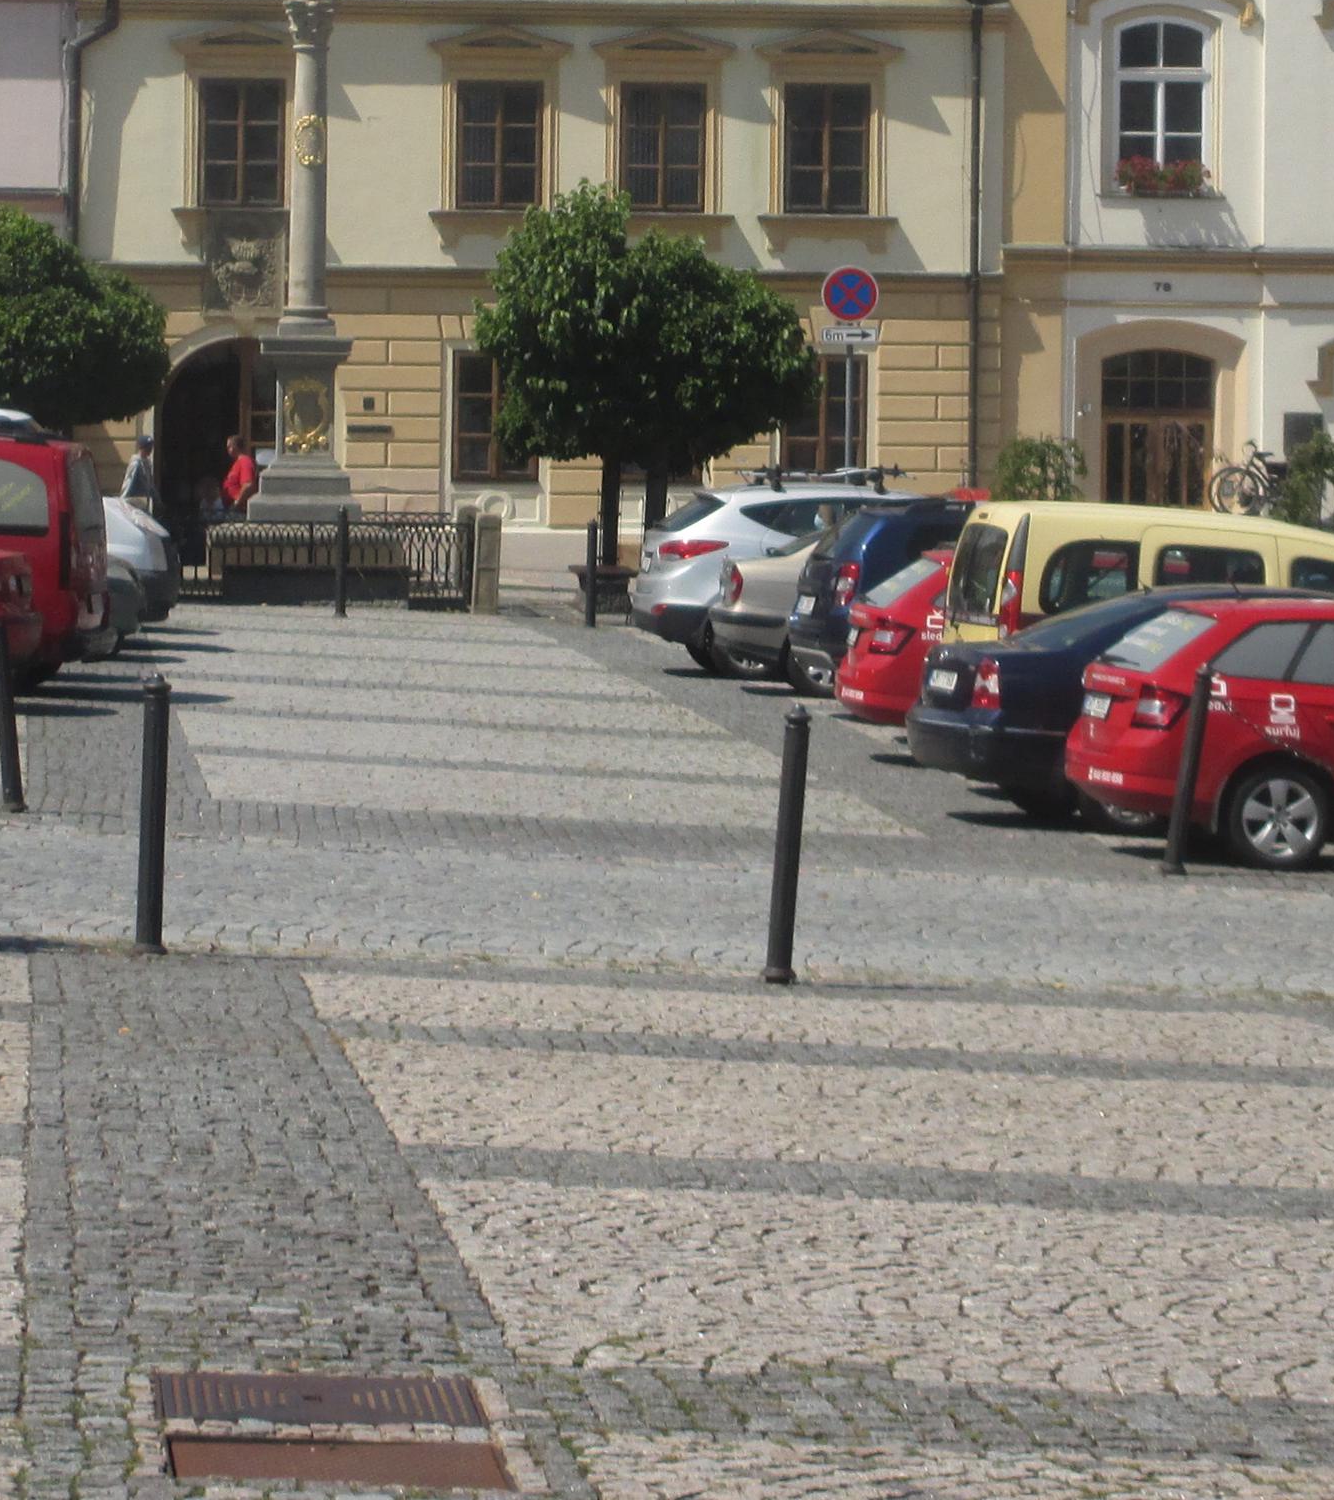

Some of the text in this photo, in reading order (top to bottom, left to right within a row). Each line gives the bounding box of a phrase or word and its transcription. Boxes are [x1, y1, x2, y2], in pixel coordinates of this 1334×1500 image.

[1153, 282, 1172, 292] 78
[825, 329, 844, 341] 6m
[1264, 725, 1301, 740] surfuj
